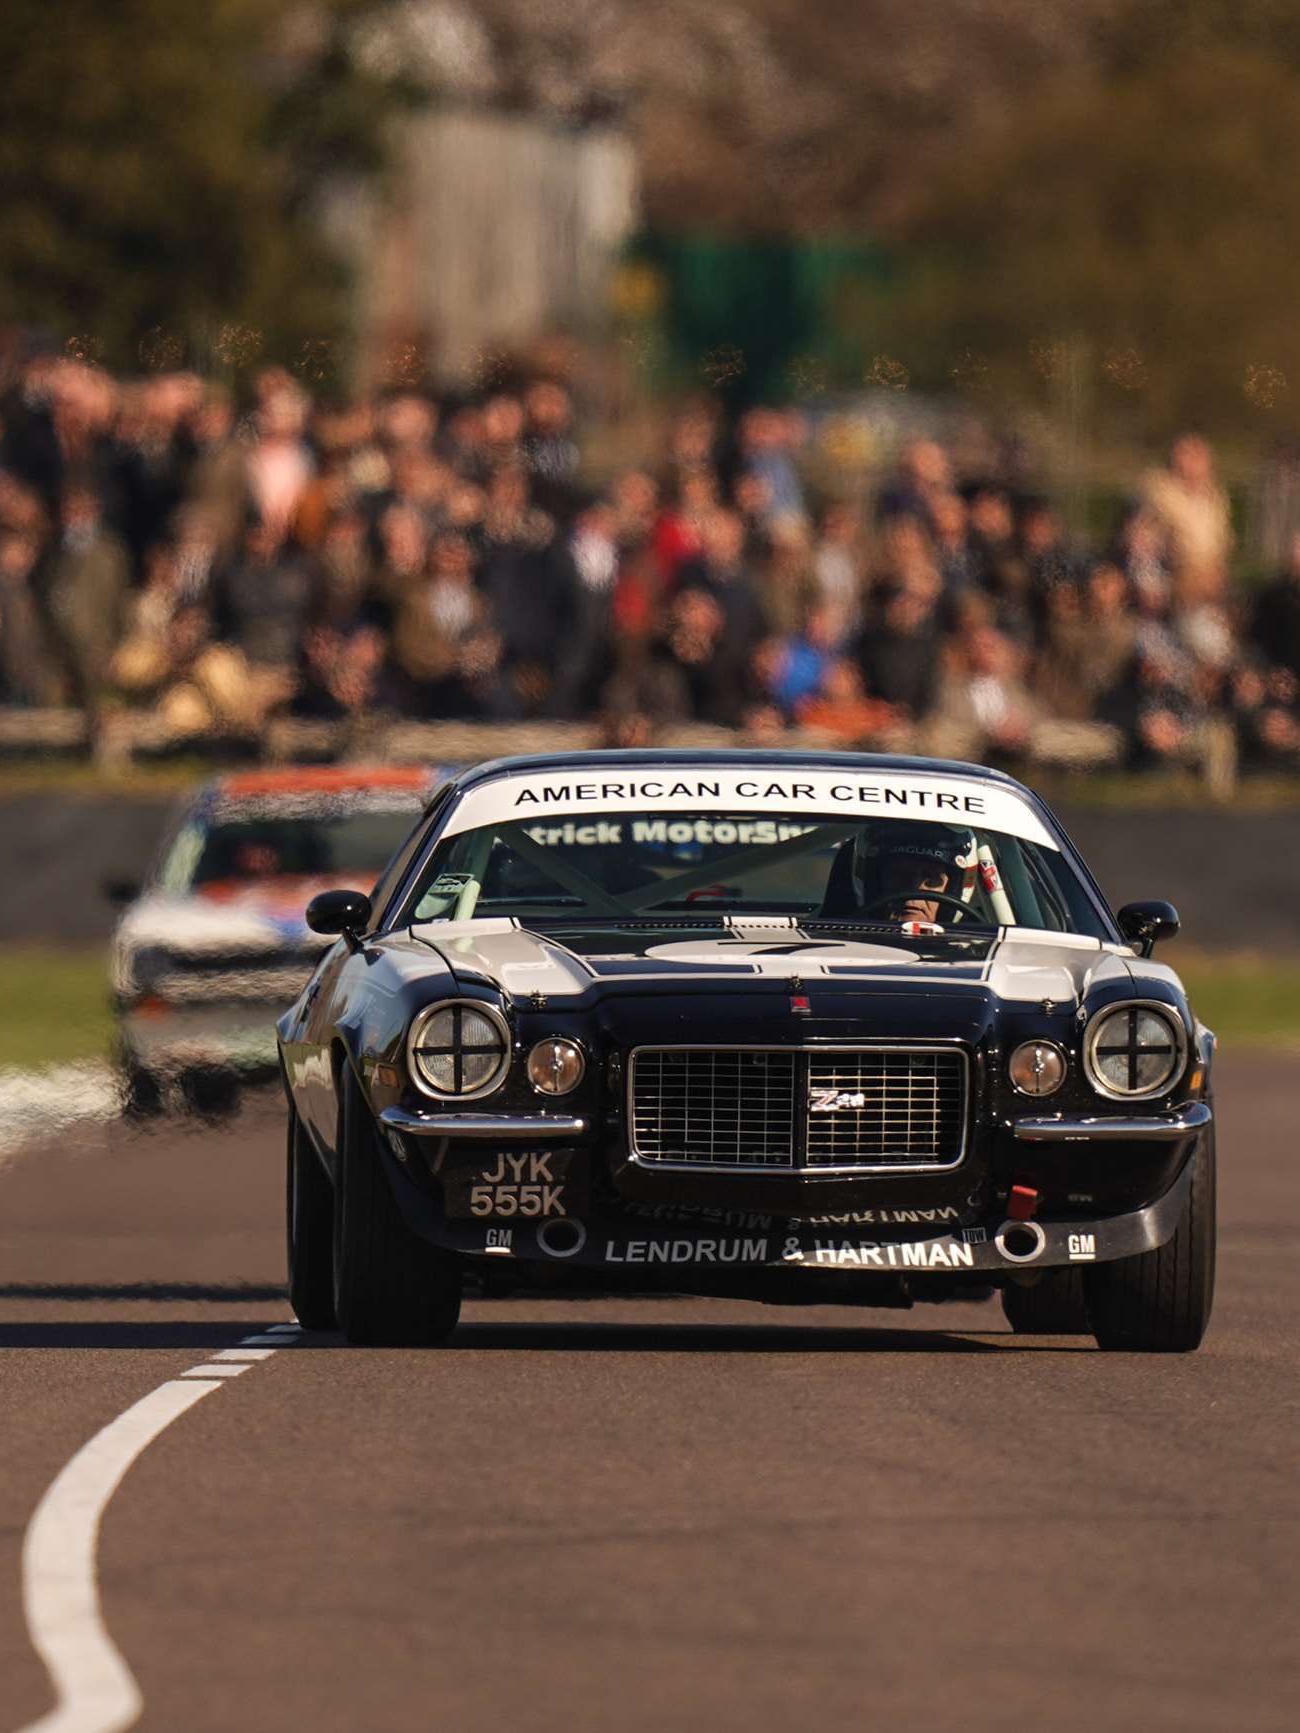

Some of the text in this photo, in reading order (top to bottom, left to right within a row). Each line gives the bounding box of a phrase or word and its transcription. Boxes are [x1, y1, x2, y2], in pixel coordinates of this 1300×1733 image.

[515, 782, 986, 814] AMERICAN CAR CENTRE
[717, 942, 846, 956] 7
[482, 1152, 554, 1183] JYK
[470, 1185, 567, 1216] 555K
[486, 1228, 513, 1247] GM
[605, 1236, 975, 1267] LENDRUM & HARTMAN
[1068, 1234, 1096, 1254] GM
